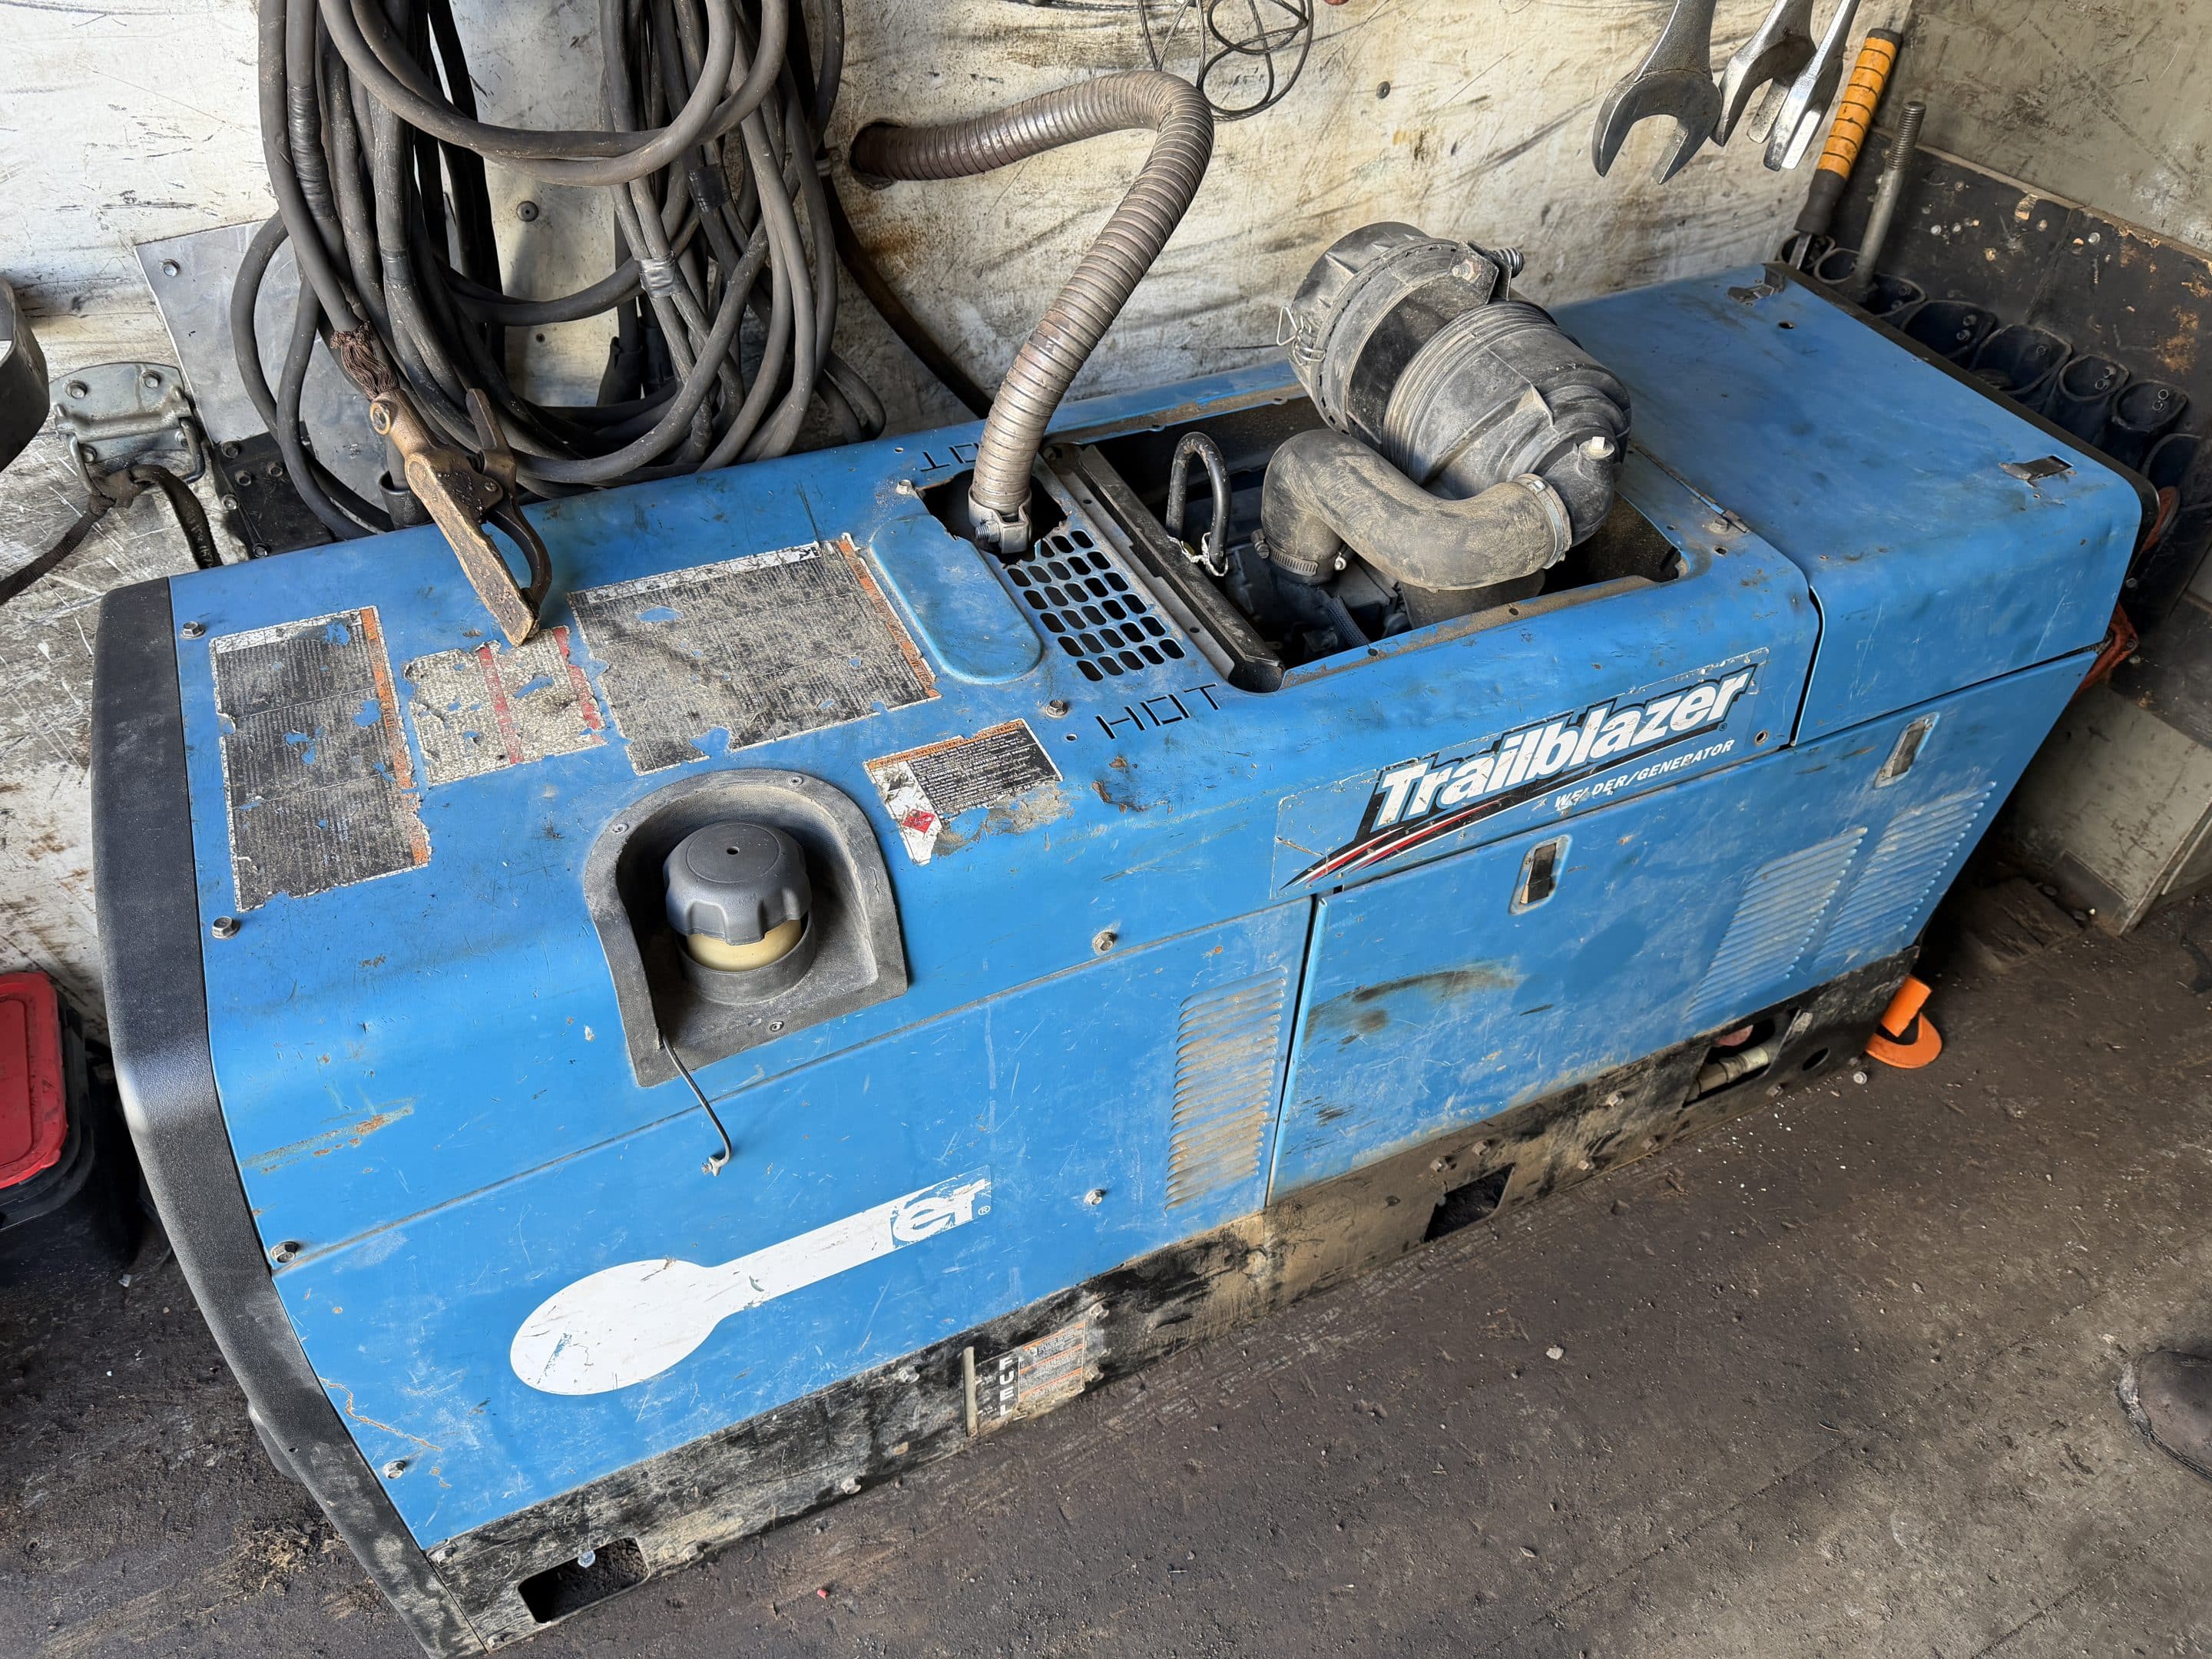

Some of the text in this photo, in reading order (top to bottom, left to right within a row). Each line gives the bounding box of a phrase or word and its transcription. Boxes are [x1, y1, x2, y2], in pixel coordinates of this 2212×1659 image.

[920, 442, 980, 472] OT
[1095, 683, 1220, 740] HOT
[998, 1356, 1015, 1417] FUEL
